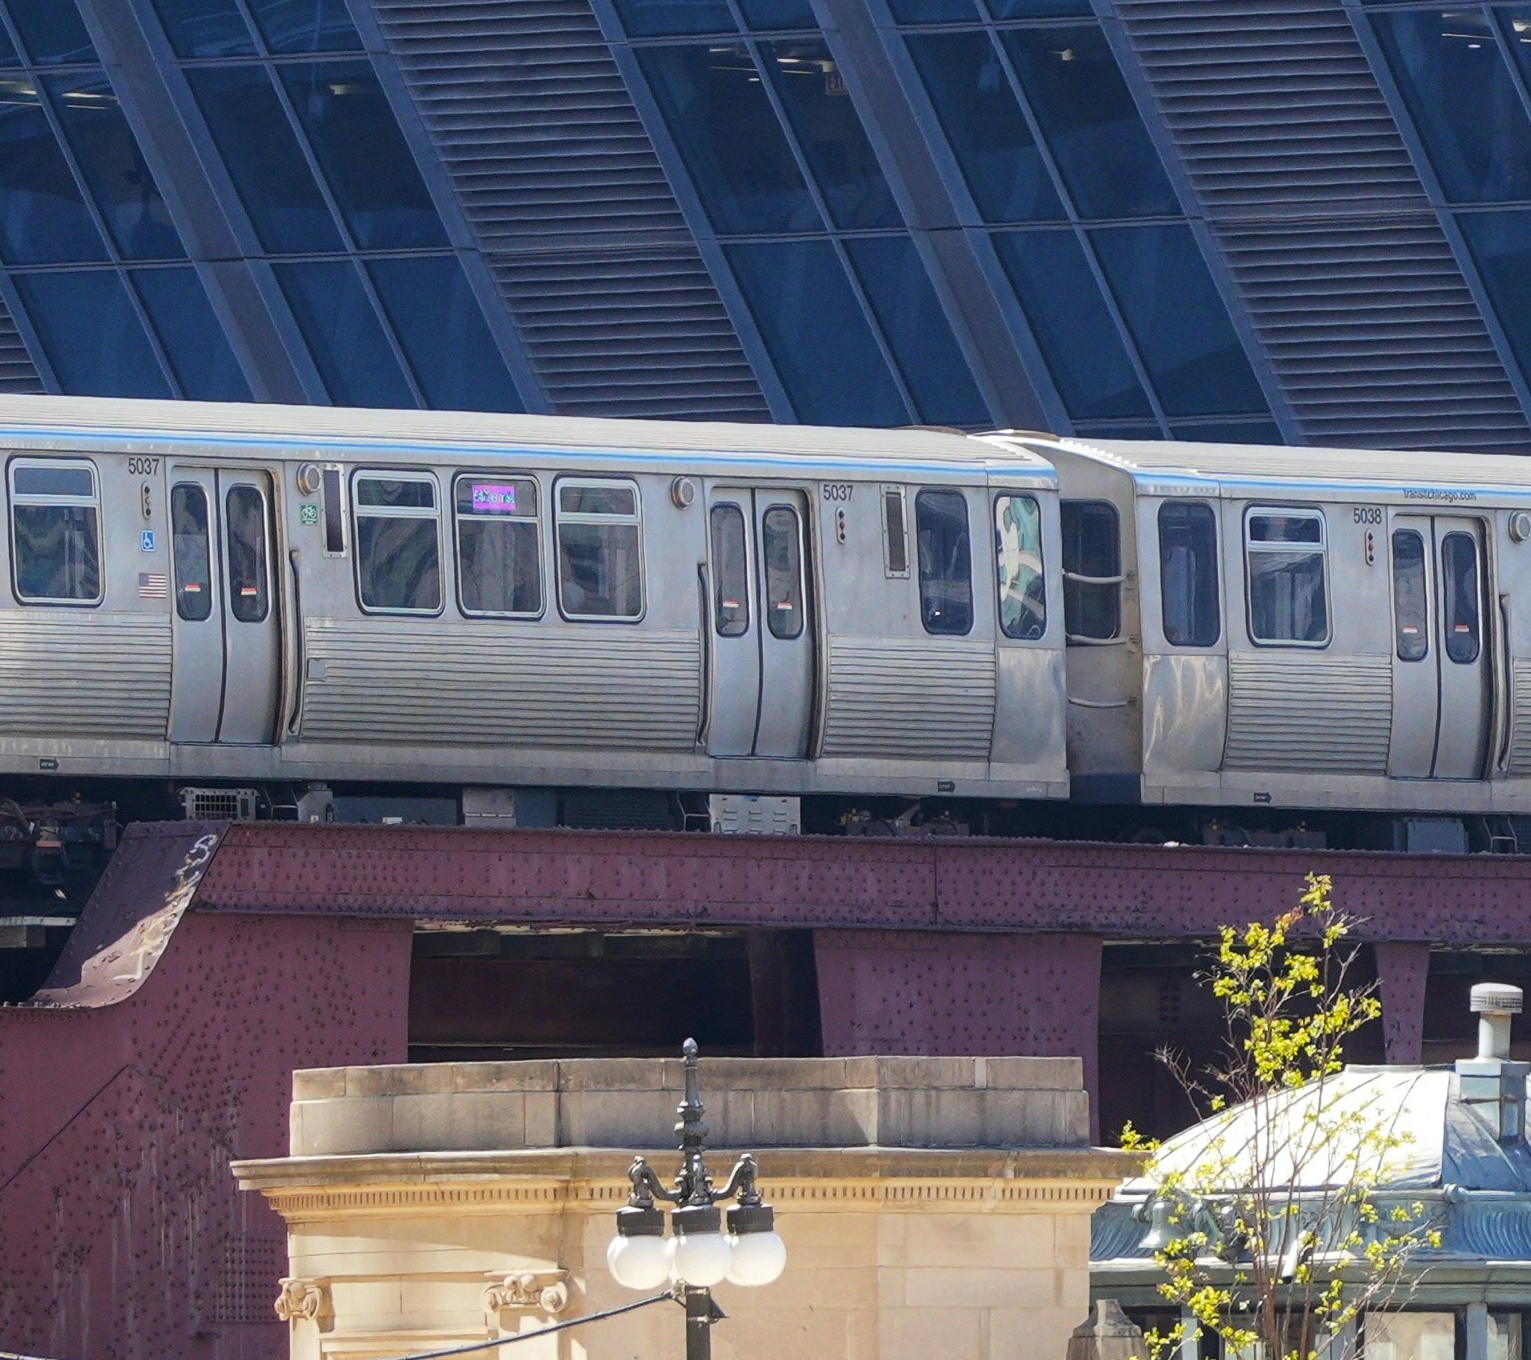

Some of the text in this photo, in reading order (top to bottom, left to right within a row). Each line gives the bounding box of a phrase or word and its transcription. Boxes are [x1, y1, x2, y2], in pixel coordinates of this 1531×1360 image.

[128, 457, 160, 475] 5037
[822, 484, 854, 501] 5037
[1353, 507, 1382, 524] 5038
